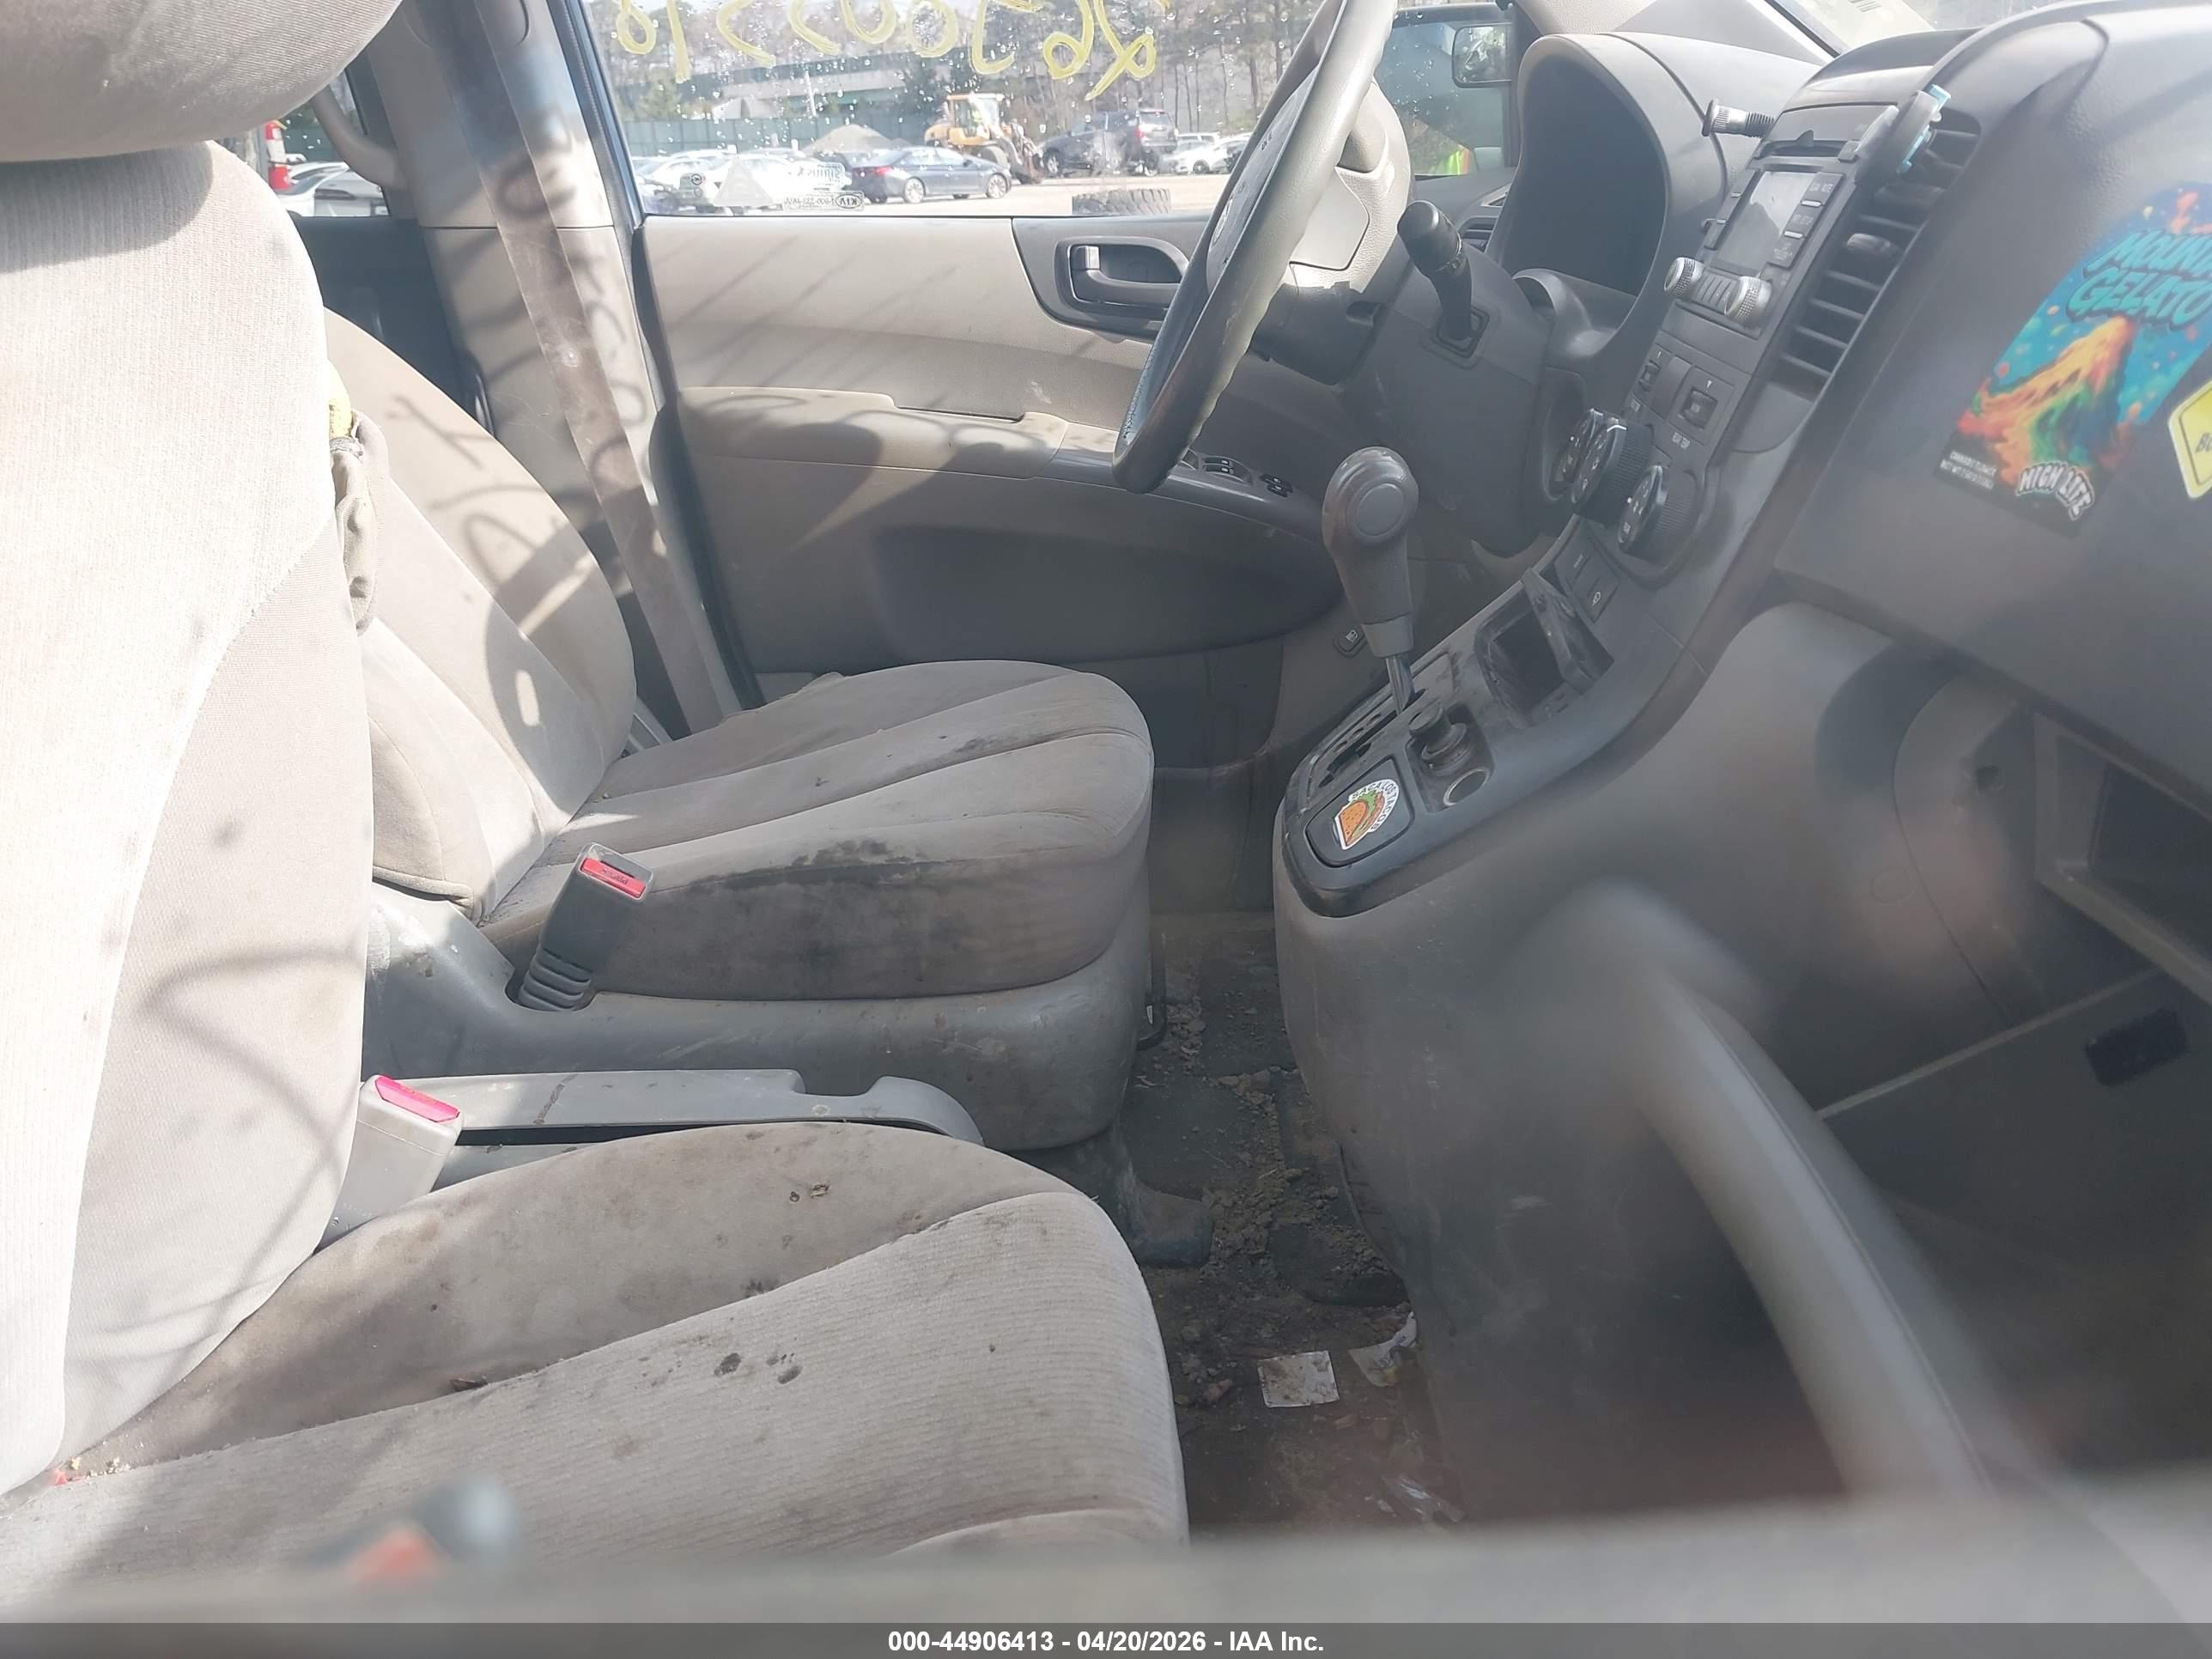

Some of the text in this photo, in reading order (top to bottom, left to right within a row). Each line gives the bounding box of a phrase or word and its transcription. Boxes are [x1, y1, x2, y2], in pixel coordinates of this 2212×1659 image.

[2067, 266, 2212, 328] GELATO
[2018, 465, 2064, 492] HIGH
[2058, 469, 2092, 517] LIFE
[1370, 791, 1397, 830] TACOS
